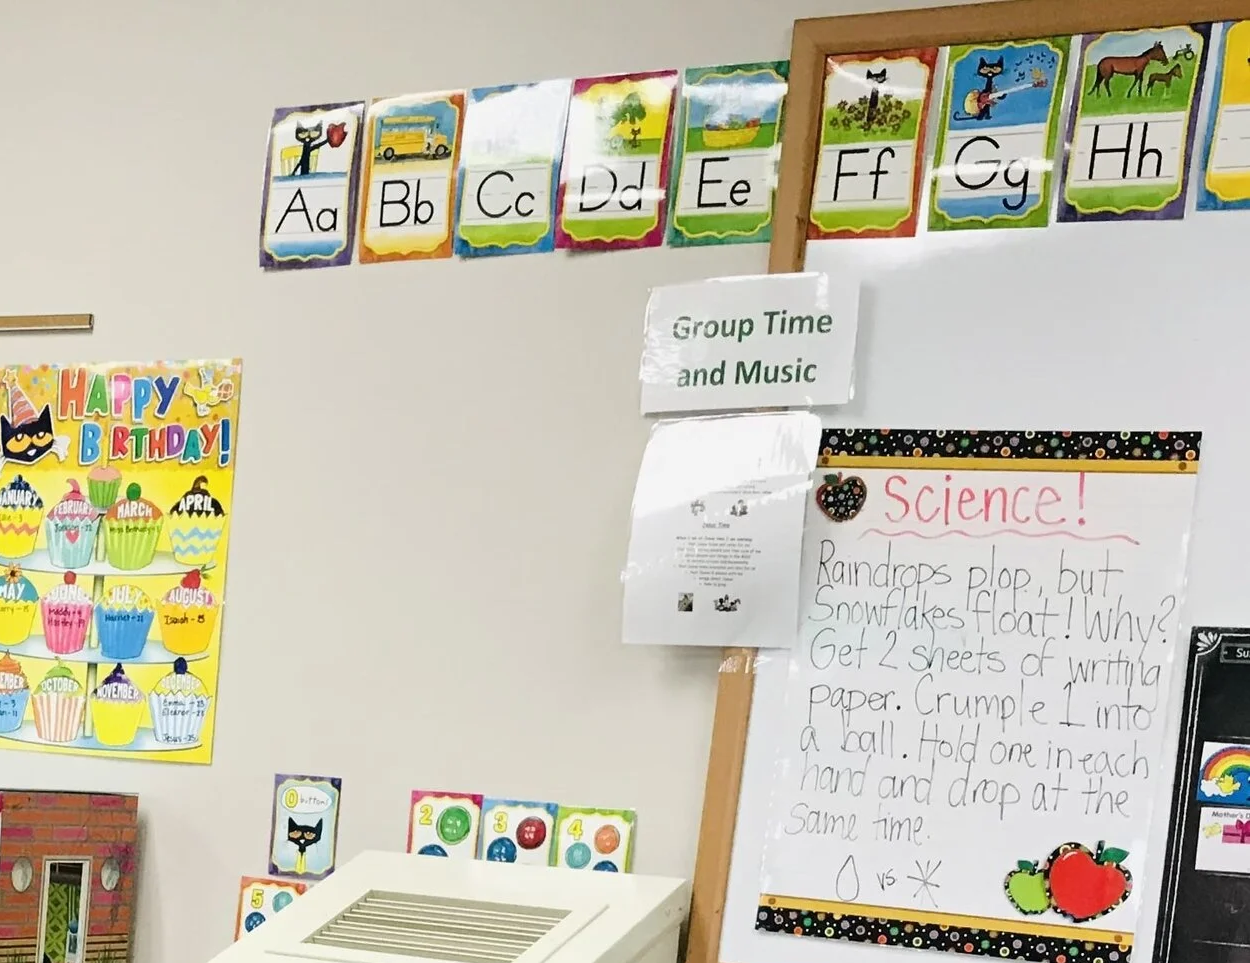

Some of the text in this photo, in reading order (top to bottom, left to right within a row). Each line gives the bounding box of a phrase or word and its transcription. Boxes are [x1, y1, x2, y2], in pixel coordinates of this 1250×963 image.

[1088, 122, 1163, 179] Hh
[579, 161, 646, 213] Dd
[696, 156, 752, 209] Ee
[833, 146, 895, 201] Ff
[954, 135, 1029, 211] Gg
[275, 187, 338, 233] Aa
[378, 178, 436, 228] Bb
[476, 169, 535, 219] Cc
[672, 310, 833, 342] Group Time
[677, 358, 817, 387] and Music
[57, 367, 181, 422] HAPPY
[54, 500, 95, 515] FEBRUARY
[117, 501, 153, 519] MARCH
[178, 494, 215, 512] APRIL
[884, 471, 1086, 526] Science!
[816, 539, 952, 601] Raindrops
[1058, 548, 1123, 597] but
[0, 582, 26, 600] MAY
[110, 585, 143, 604] JULY
[168, 588, 212, 606] AUGUST
[808, 584, 965, 630] Snowflakes
[1084, 595, 1176, 656] Why?
[41, 677, 80, 692] OCTOBER
[810, 627, 1162, 708] Get 2 sheets of writing
[96, 682, 139, 699] NOVEMBER
[809, 673, 1152, 733] paper. Crumple 1 into
[800, 724, 820, 753] a
[918, 724, 980, 764] Hold
[991, 740, 1042, 768] one
[285, 788, 298, 809] 0
[800, 752, 1131, 821] hand and drop at the
[419, 805, 433, 826] 2
[493, 812, 508, 833] 3
[567, 820, 584, 841] 4
[251, 888, 264, 909] 5
[877, 872, 896, 889] vs
